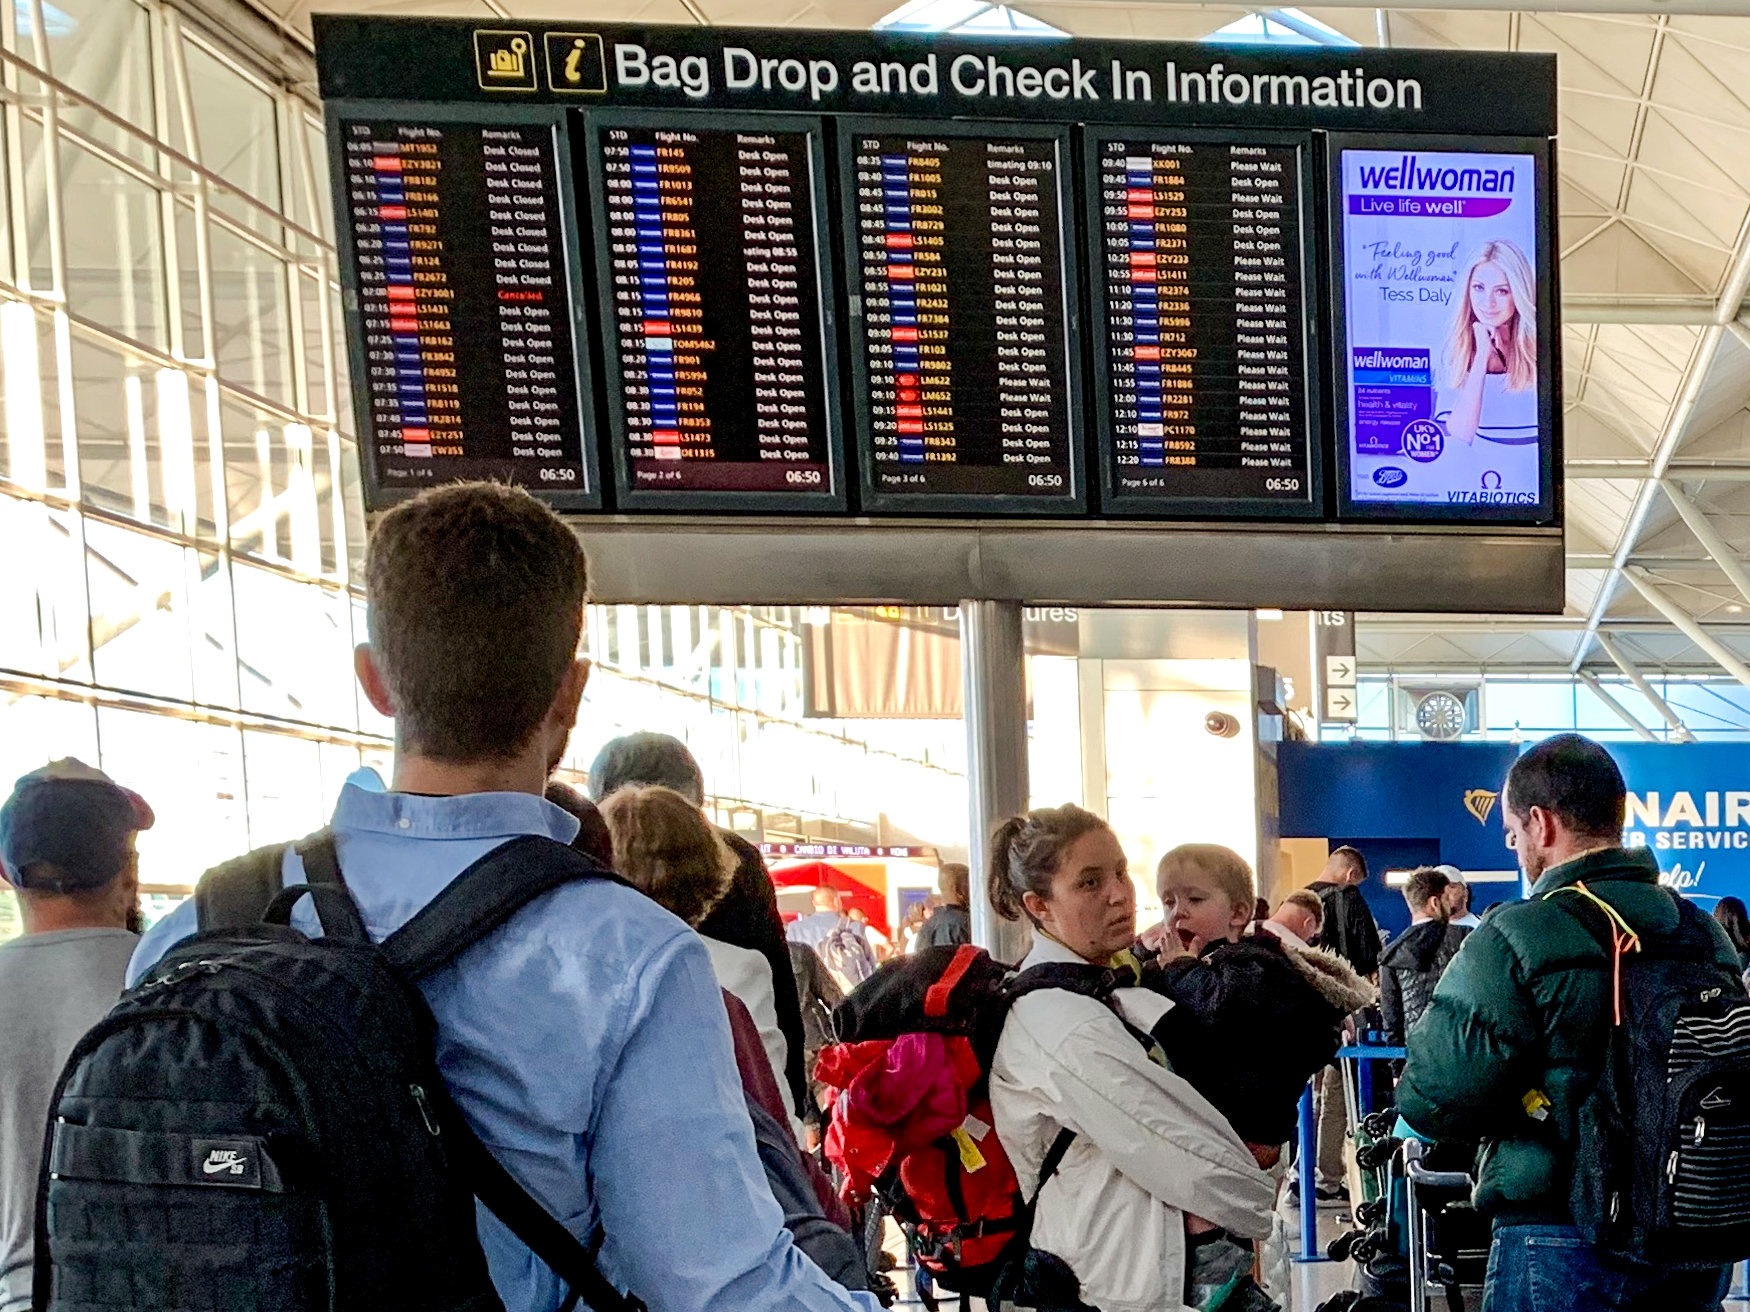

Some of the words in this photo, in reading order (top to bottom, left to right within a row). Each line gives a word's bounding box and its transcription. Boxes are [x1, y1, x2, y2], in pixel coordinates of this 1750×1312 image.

[615, 44, 709, 98] Bag
[724, 47, 838, 100] Drop
[853, 54, 938, 94] and
[951, 55, 1099, 99] Check
[1112, 60, 1151, 101] In
[1167, 62, 1421, 109] Information
[863, 140, 880, 149] STD
[907, 142, 932, 152] Flight
[987, 144, 1024, 153] Remarks
[1108, 143, 1125, 151] STD
[1152, 144, 1176, 154] Flight
[1231, 146, 1266, 155] Remarks
[1102, 159, 1125, 167] 09:40
[1231, 162, 1258, 171] Please
[1260, 163, 1281, 171] Wait
[1360, 156, 1514, 192] wellwoman
[1361, 198, 1394, 212] Live
[1398, 199, 1421, 213] life
[1425, 200, 1463, 214] well
[1105, 206, 1128, 215] 09:55
[1233, 209, 1253, 218] Desk
[1256, 210, 1279, 219] Open
[1107, 238, 1129, 247] 10:05
[1234, 241, 1255, 249] Desk
[1257, 241, 1280, 251] Open
[1425, 242, 1459, 266] good
[1109, 269, 1130, 278] 10:55
[1235, 272, 1262, 281] Please
[1264, 273, 1285, 281] Wait
[1355, 264, 1382, 281] with
[1109, 285, 1131, 294] 11:10
[1235, 287, 1262, 296] Please
[1264, 288, 1286, 297] Wait
[1379, 287, 1414, 301] Tess
[1419, 288, 1452, 306] Daly
[1112, 332, 1133, 341] 11:30
[1237, 334, 1264, 343] Please
[1266, 335, 1287, 344] Wait
[869, 345, 892, 353] 09:05
[998, 347, 1019, 356] Desk
[1021, 347, 1045, 357] Open
[1112, 348, 1134, 356] 11:45
[1238, 350, 1265, 359] Please
[1267, 351, 1287, 359] Wait
[1354, 351, 1428, 369] wellwoman
[871, 375, 894, 384] 09:10
[999, 378, 1027, 386] Please
[1029, 378, 1050, 387] Wait
[1389, 374, 1427, 384] VITAMINS
[872, 391, 895, 399] 09:10
[1000, 393, 1028, 402] Please
[1029, 394, 1051, 402] Wait
[1114, 394, 1136, 402] 12:00
[1240, 396, 1266, 405] Please
[1268, 397, 1289, 405] Wait
[1358, 400, 1383, 409] health
[1115, 409, 1137, 418] 12:10
[1240, 411, 1267, 420] Please
[1269, 412, 1290, 421] Wait
[874, 421, 897, 430] 09:20
[1002, 423, 1023, 432] Desk
[1025, 424, 1049, 433] Open
[1116, 425, 1138, 433] 12:10
[1241, 427, 1267, 436] Please
[1269, 428, 1290, 436] Wait
[540, 469, 575, 480] 06:50
[786, 471, 820, 483] 06:50
[882, 474, 901, 484] Page
[1029, 475, 1062, 486] 06:50
[1266, 479, 1299, 490] 06:50
[1447, 490, 1536, 504] VITABIOTICS
[827, 845, 838, 855] DI
[210, 1150, 238, 1162] NIKE
